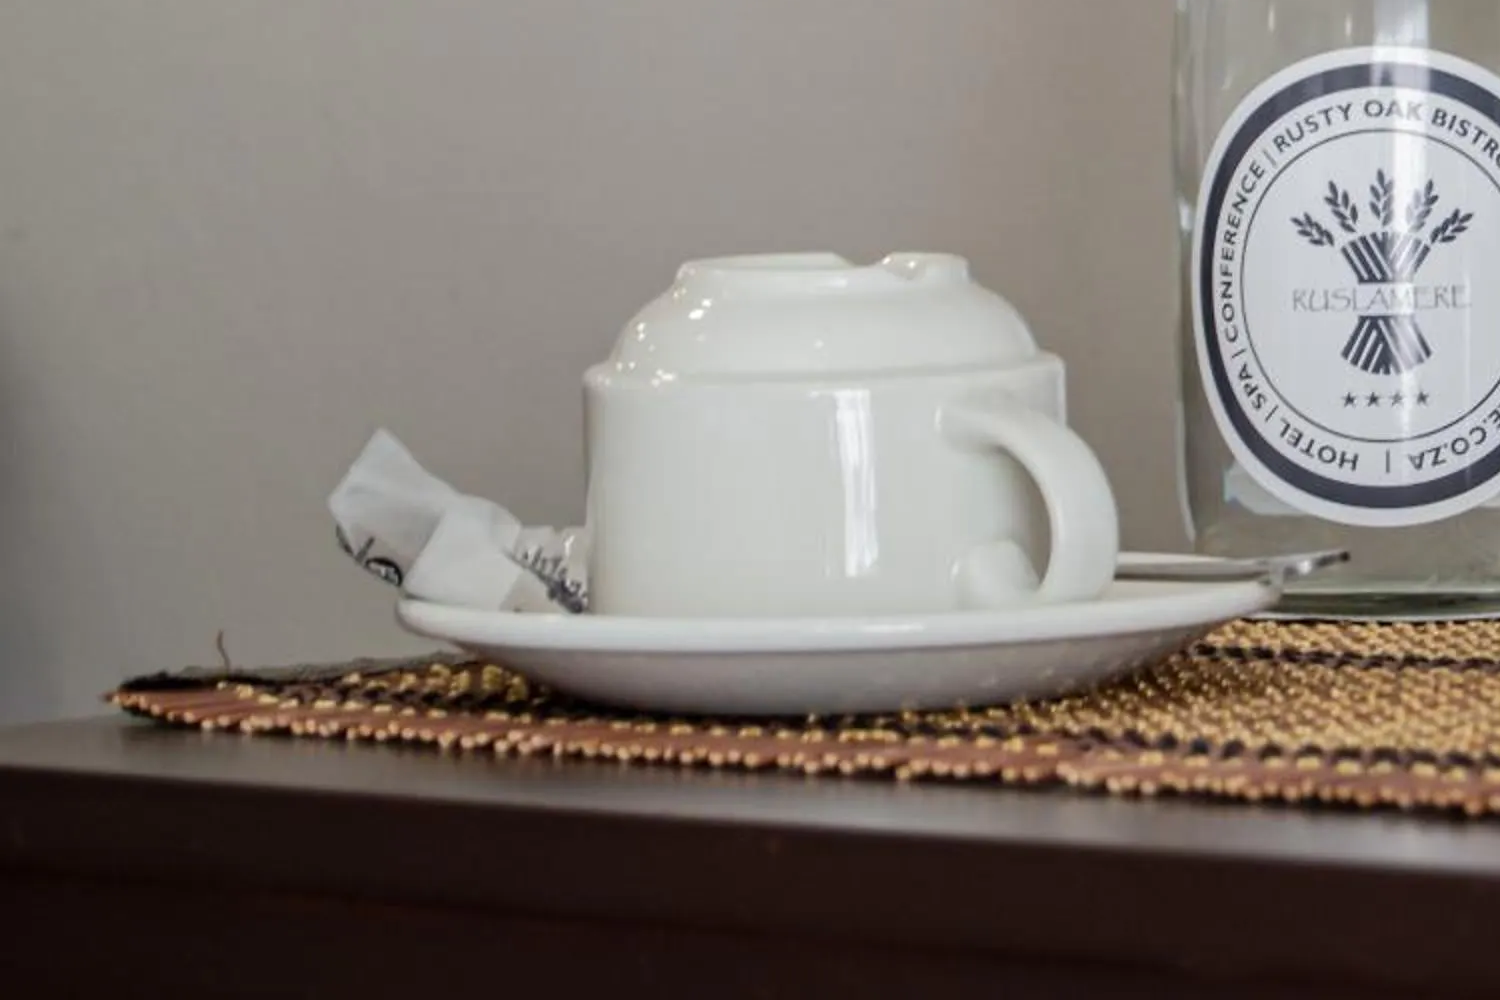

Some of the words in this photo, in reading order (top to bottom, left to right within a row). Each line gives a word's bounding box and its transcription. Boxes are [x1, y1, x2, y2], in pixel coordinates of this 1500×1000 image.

[1272, 102, 1353, 153] RUSTY
[1363, 99, 1424, 122] OAK
[1219, 159, 1266, 343] CONFERENCE
[1292, 284, 1472, 313] RUSLAMERE
[1238, 363, 1268, 410] SPA
[1279, 416, 1359, 472] HOTEL
